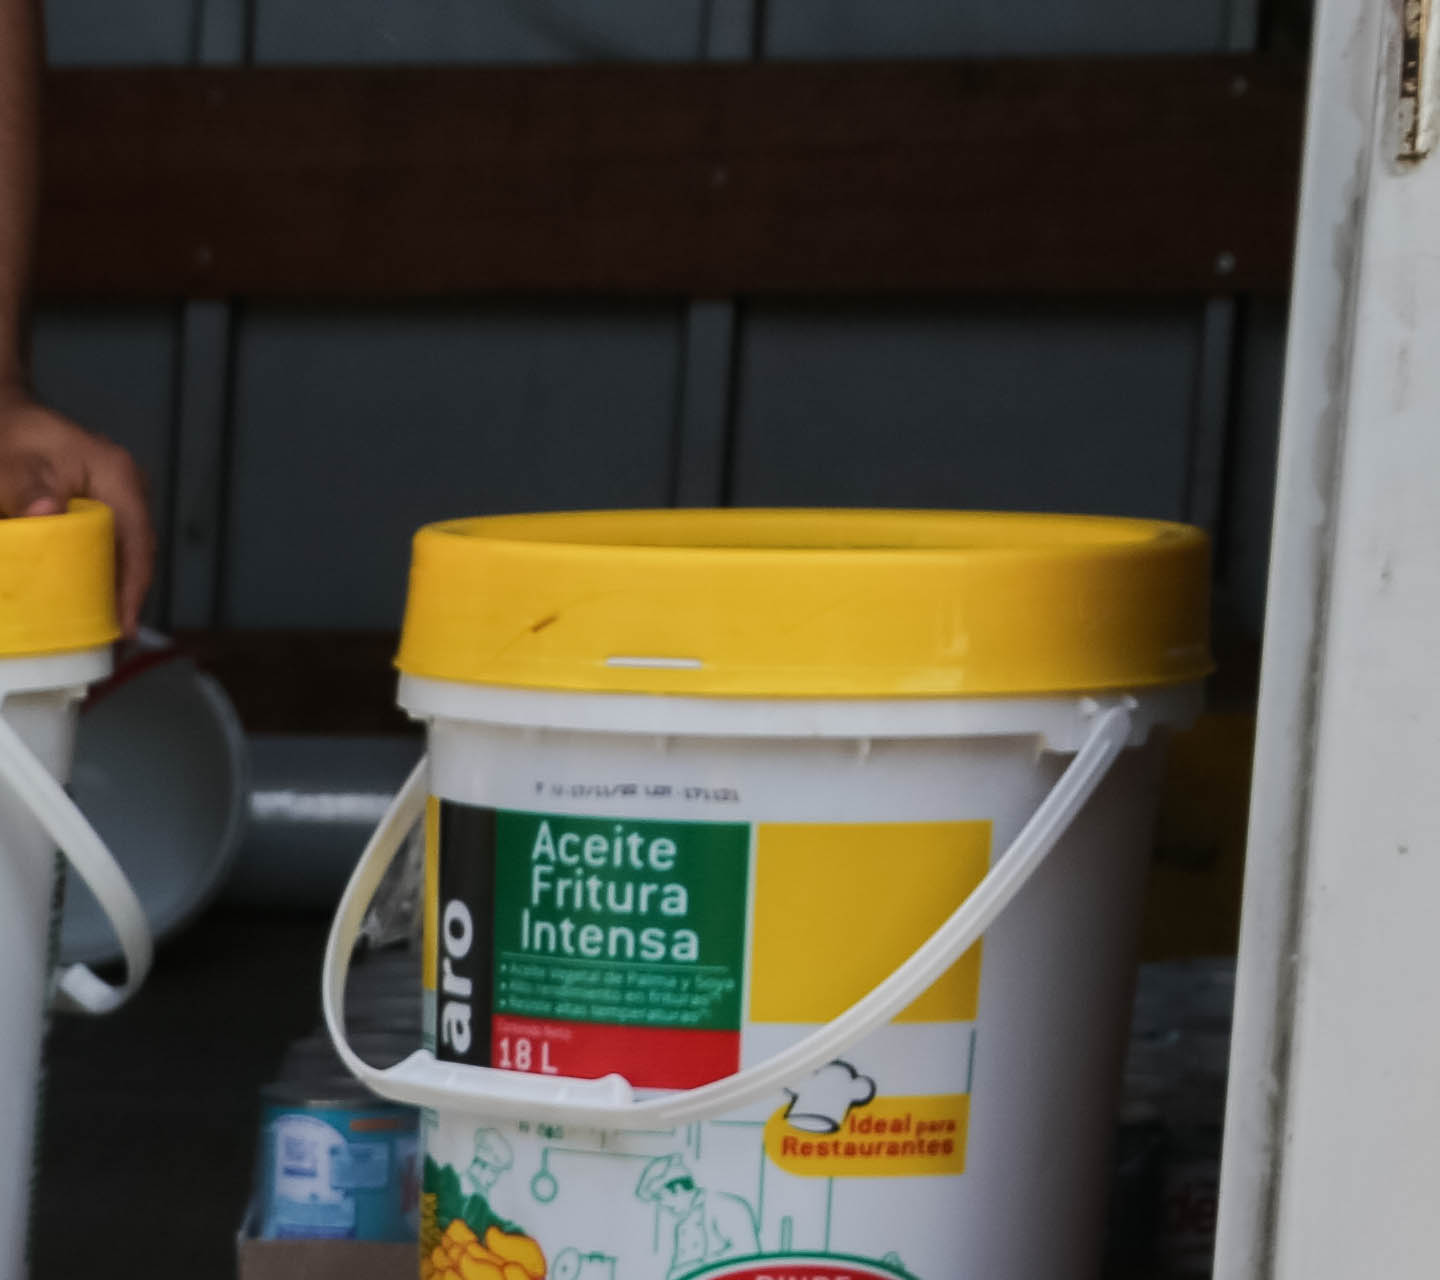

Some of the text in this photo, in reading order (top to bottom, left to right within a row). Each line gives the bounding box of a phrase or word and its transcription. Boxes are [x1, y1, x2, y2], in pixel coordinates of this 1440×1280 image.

[531, 819, 678, 871] Aceite
[531, 863, 689, 916] Fritura
[520, 907, 700, 962] Intensa
[441, 899, 474, 1054] aro
[498, 1036, 558, 1074] 18 L
[781, 1135, 955, 1157] Restaurantes
[849, 1113, 957, 1138] Ideal para
